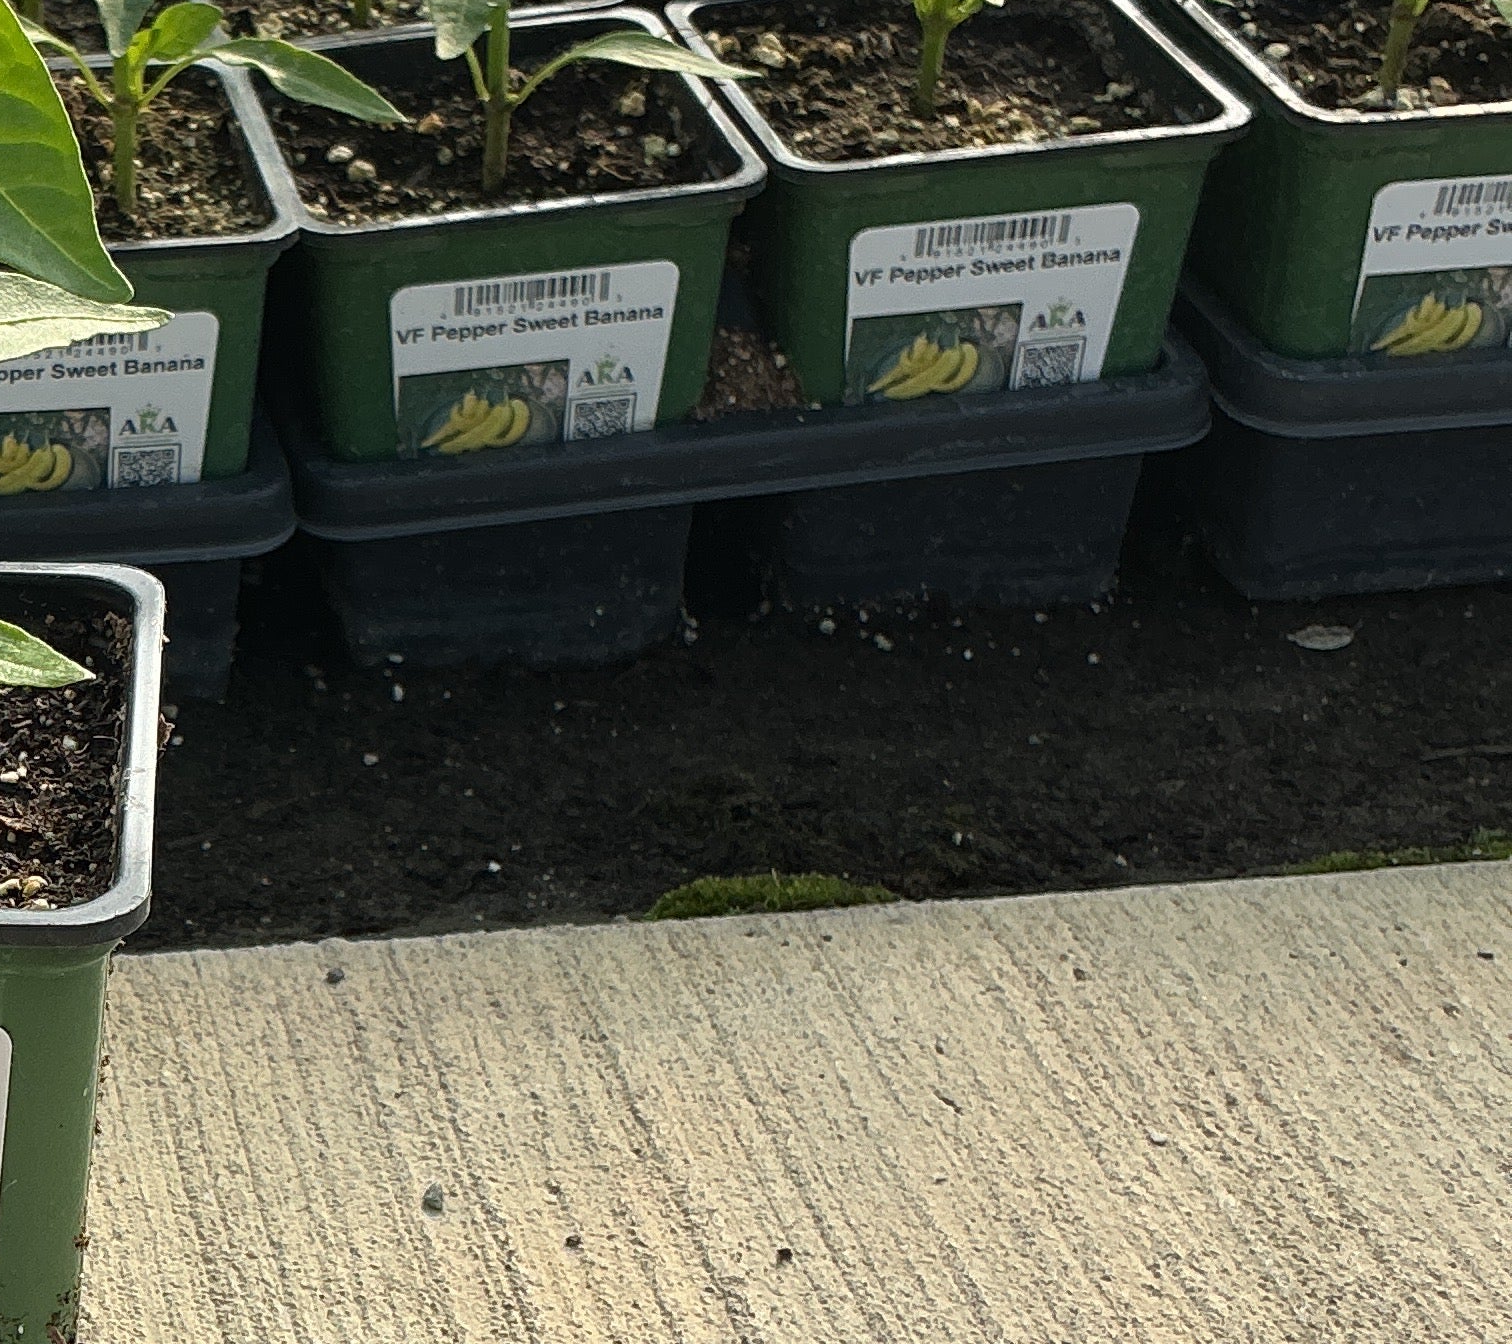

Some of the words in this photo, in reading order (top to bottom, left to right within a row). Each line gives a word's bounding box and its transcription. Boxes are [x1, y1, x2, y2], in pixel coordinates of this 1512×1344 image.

[1373, 225, 1401, 243] VF
[1405, 223, 1482, 243] Pepper
[854, 270, 883, 287] VF
[889, 264, 966, 285] Pepper
[970, 256, 1035, 277] Sweet
[1041, 249, 1121, 269] Banana
[395, 327, 425, 345] VF
[431, 322, 508, 344] Pepper
[513, 313, 578, 334] Sweet
[584, 306, 664, 326] Banana
[50, 361, 118, 380] Sweet
[123, 356, 206, 376] Banana
